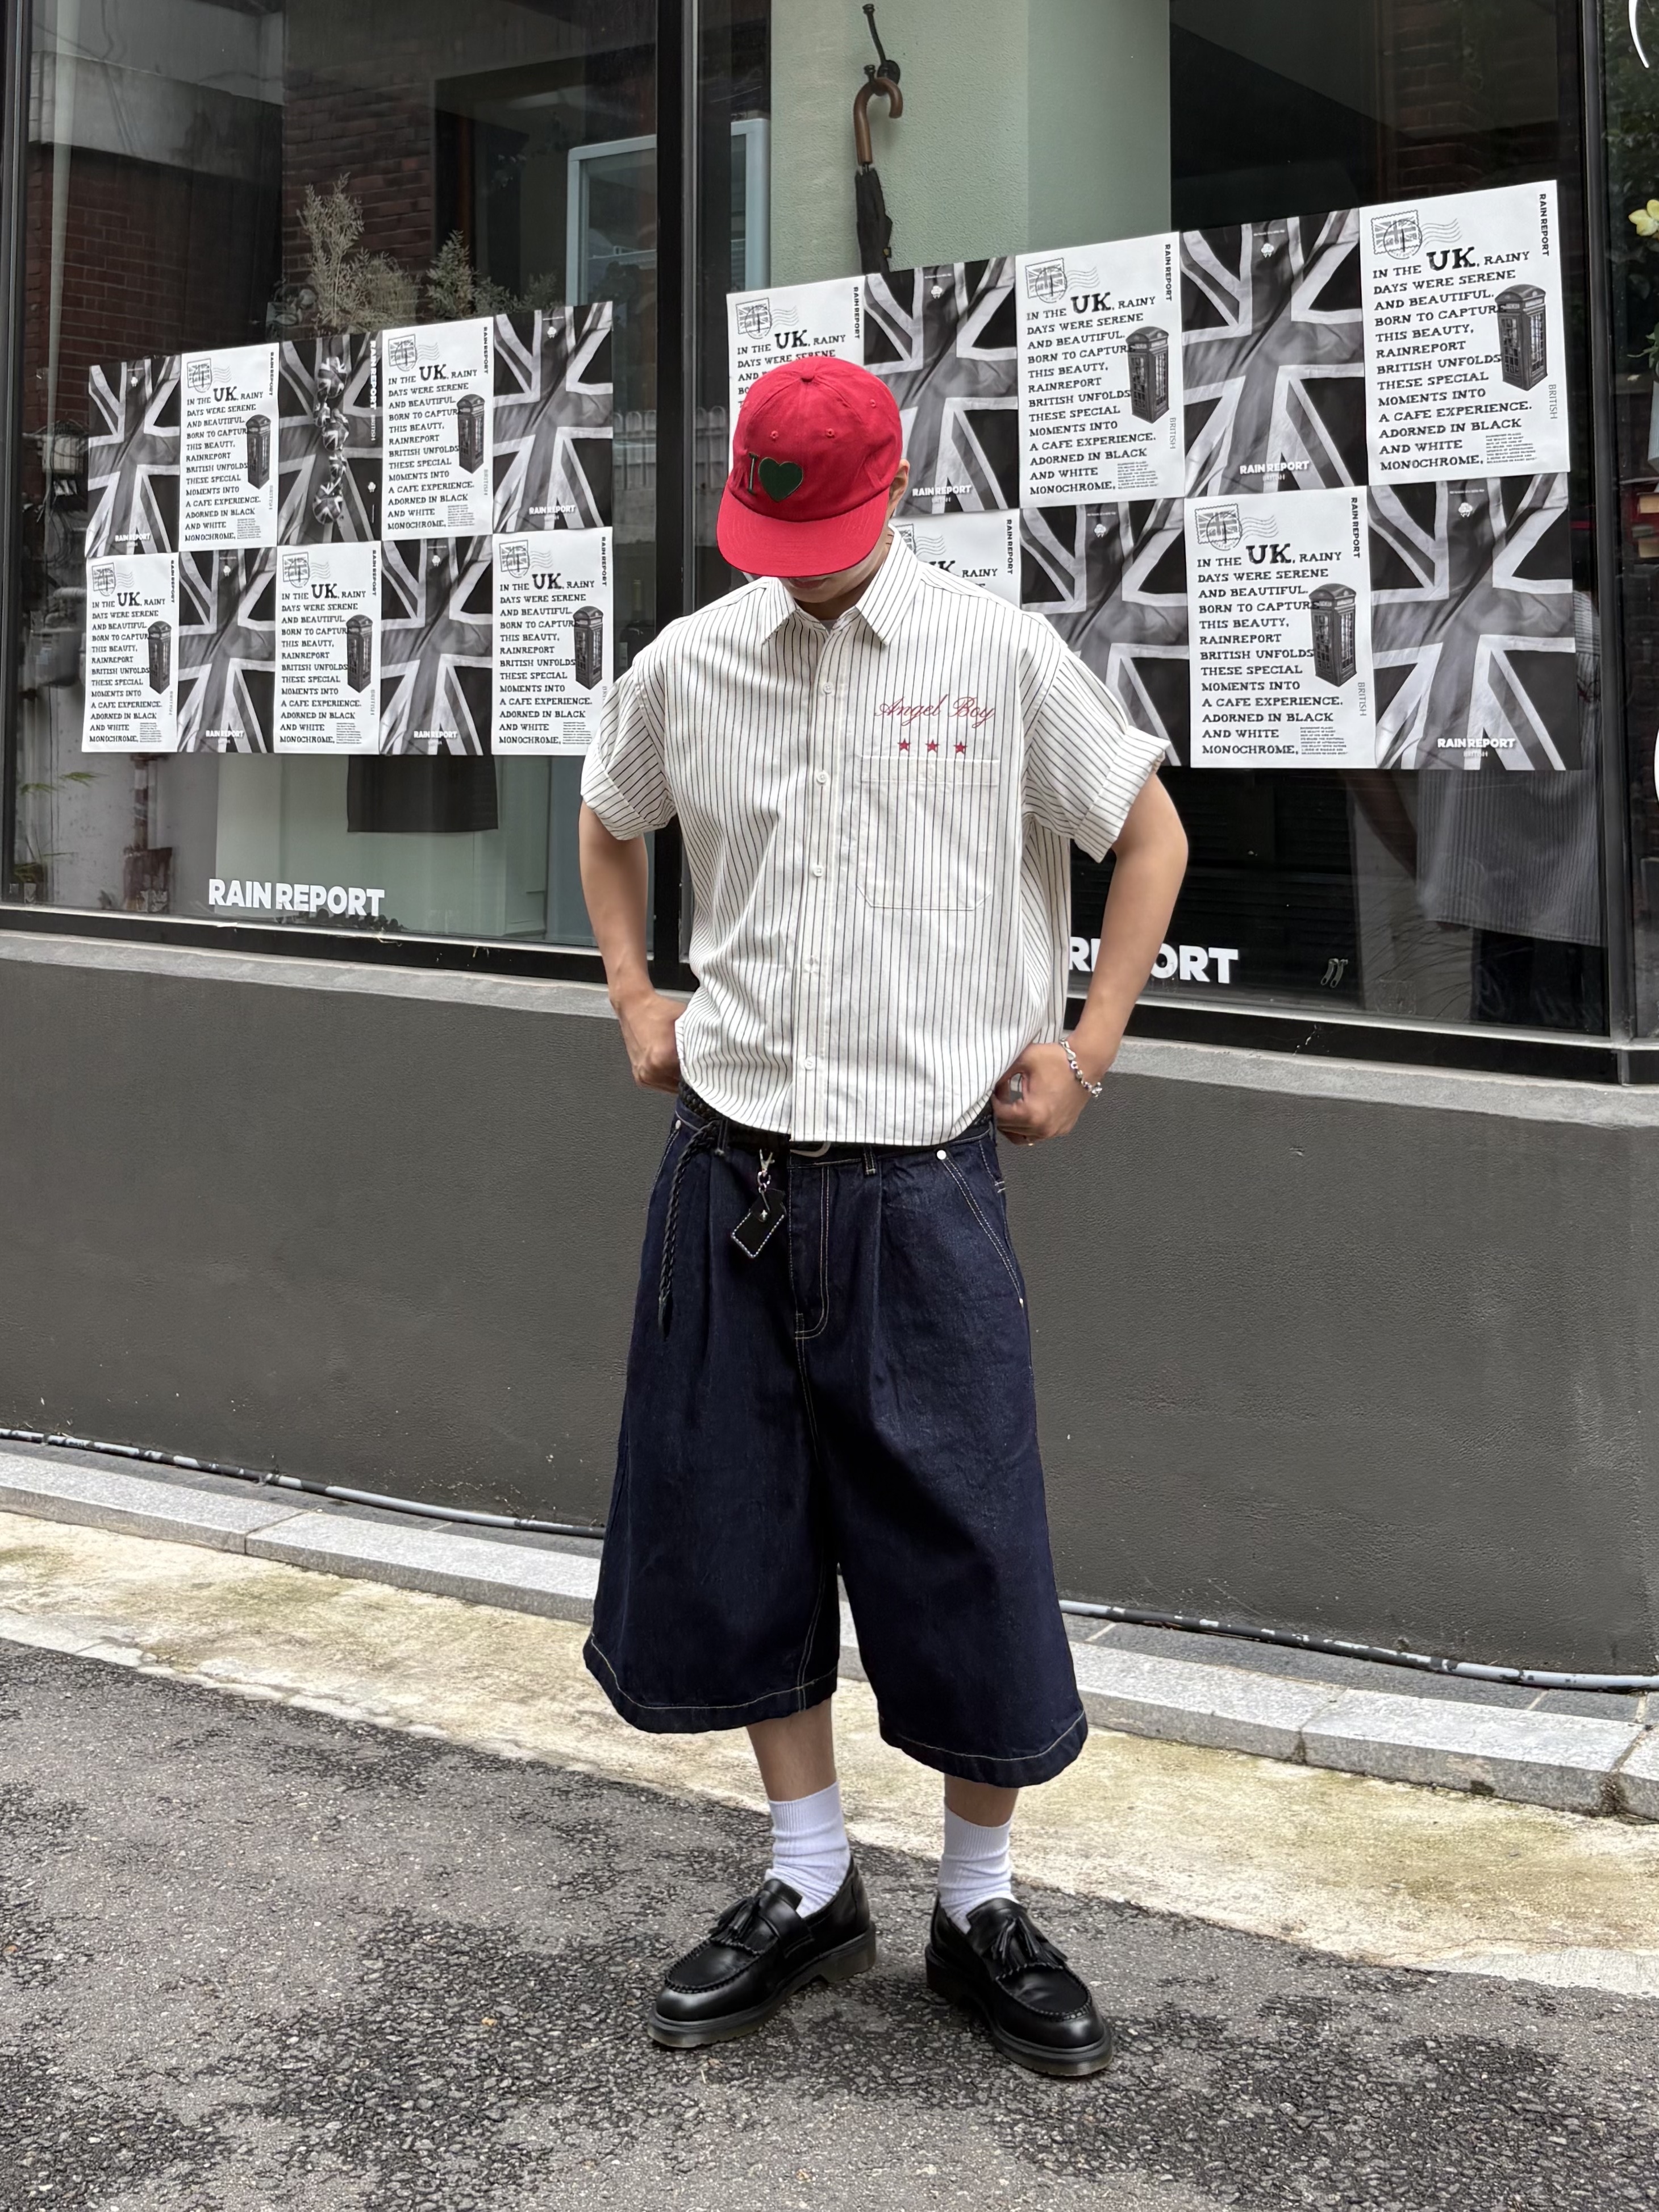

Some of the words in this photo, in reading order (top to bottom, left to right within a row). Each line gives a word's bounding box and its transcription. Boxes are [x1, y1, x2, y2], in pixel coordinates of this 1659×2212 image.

[1373, 269, 1387, 278] IN
[1393, 265, 1420, 275] THE
[1484, 251, 1529, 264] RAINY
[1374, 283, 1407, 294] DAYS
[1412, 277, 1453, 289] WERE
[1459, 270, 1515, 284] SERENE
[1043, 309, 1066, 318] THE
[1119, 297, 1154, 308] RAINY
[1374, 299, 1404, 310] AND
[1027, 325, 1054, 334] DAYS
[1059, 320, 1092, 330] WERE
[1097, 313, 1143, 326] SERENE
[1375, 314, 1411, 326] BORN
[1416, 312, 1433, 321] TO
[1375, 331, 1406, 341] THIS
[752, 344, 771, 353] THE
[814, 335, 845, 345] RAINY
[1028, 340, 1052, 349] AND
[1377, 341, 1465, 358] RAINREPORT
[737, 359, 761, 368] DAYS
[765, 355, 792, 364] WERE
[1028, 353, 1057, 363] BORN
[1377, 361, 1431, 374] BRITISH
[1438, 353, 1500, 367] UNFOLDS
[738, 372, 758, 381] AND
[1028, 369, 1053, 377] THIS
[1028, 377, 1101, 392] RAINREPORT
[1377, 378, 1422, 390] THESE
[1428, 372, 1488, 385] SPECIAL
[1028, 395, 1073, 407] BRITISH
[1078, 389, 1130, 401] UNFOLDS
[1378, 392, 1447, 406] MOMENTS
[1453, 388, 1485, 399] INTO
[1029, 411, 1065, 421] THESE
[1070, 406, 1120, 417] SPECIAL
[1394, 410, 1431, 420] CAFE
[1029, 424, 1085, 436] MOMENTS
[1090, 421, 1117, 430] INTO
[1379, 425, 1445, 438] ADORNED
[1451, 423, 1465, 432] IN
[1471, 418, 1521, 430] BLACK
[1042, 440, 1072, 449] CAFE
[1379, 444, 1410, 454] AND
[1415, 440, 1462, 451] WHITE
[1030, 454, 1083, 465] ADORNED
[1088, 452, 1100, 460] IN
[1105, 448, 1146, 459] BLACK
[1030, 471, 1054, 480] AND
[1058, 468, 1097, 477] WHITE
[1216, 557, 1241, 565] THE
[1299, 552, 1341, 562] RAINY
[962, 568, 998, 578] RAINY
[1233, 572, 1270, 580] WERE
[1276, 569, 1328, 578] SERENE
[1199, 604, 1231, 613] BORN
[1200, 634, 1281, 644] RAINREPORT
[1200, 651, 1249, 659] BRITISH
[1256, 649, 1314, 657] UNFOLDS
[1201, 666, 1241, 675] THESE
[1247, 665, 1302, 674] SPECIAL
[1202, 682, 1264, 690] MOMENTS
[875, 694, 948, 726] Angel
[949, 697, 995, 728] Boy
[1286, 713, 1333, 721] BLACK
[209, 878, 272, 909] RAIN
[276, 882, 385, 917] REPORT
